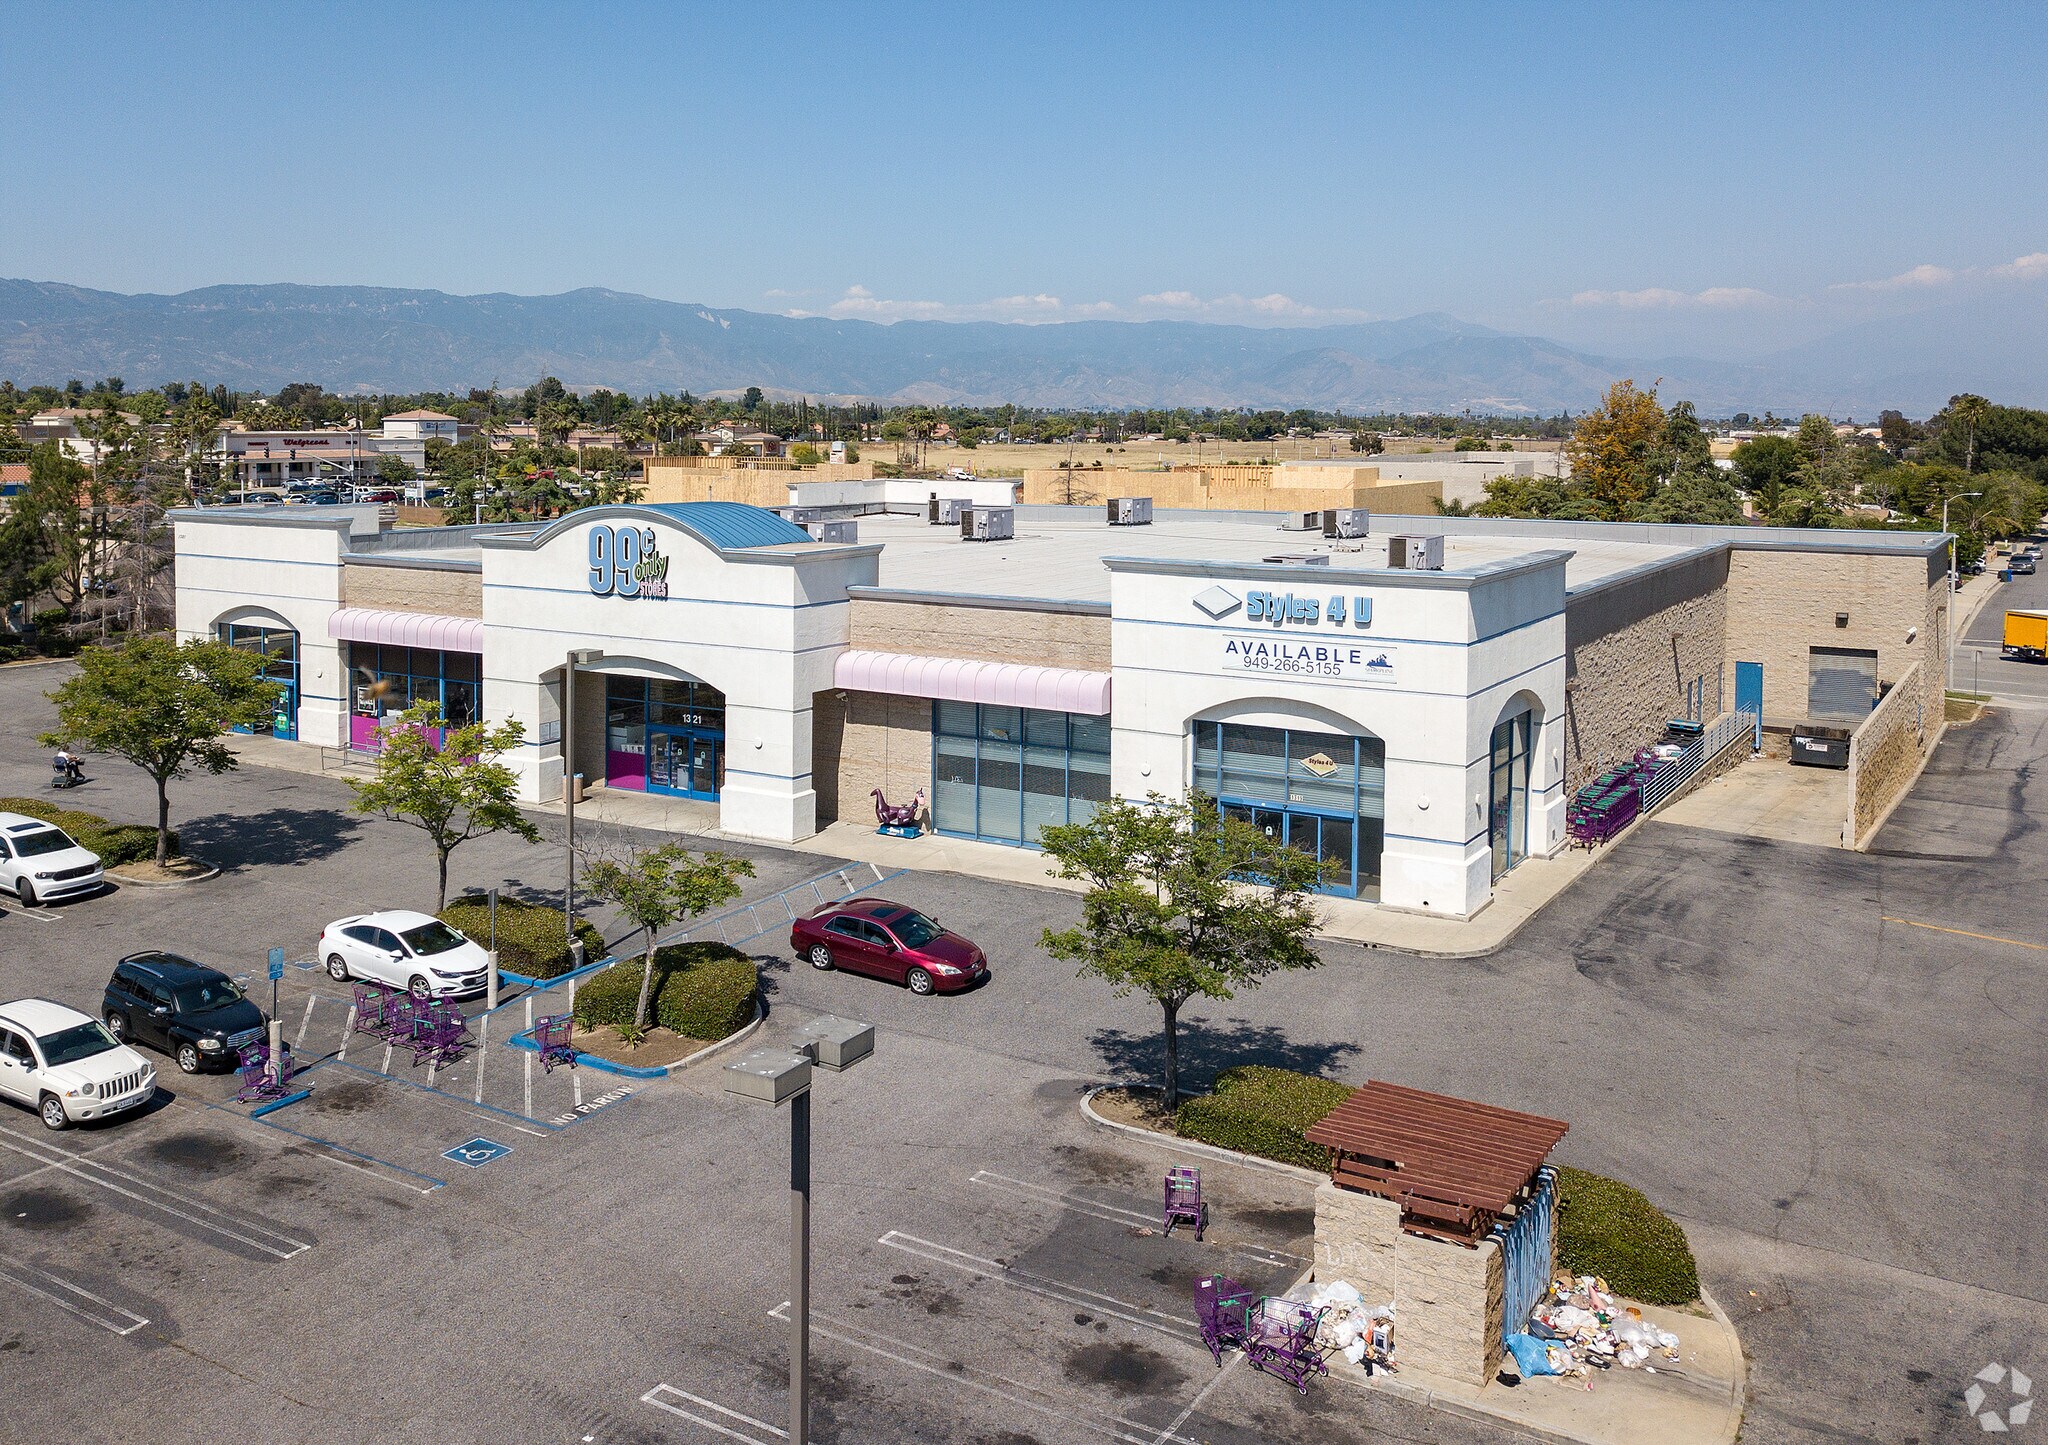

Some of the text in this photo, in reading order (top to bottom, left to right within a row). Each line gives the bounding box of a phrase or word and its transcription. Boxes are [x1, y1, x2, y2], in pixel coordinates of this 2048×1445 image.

[283, 438, 330, 447] Walgreens
[634, 551, 668, 581] only
[639, 580, 667, 598] STORES
[1247, 590, 1373, 624] Styles 4 U
[1226, 640, 1361, 664] AVAILABLE
[1243, 655, 1341, 676] 949-266-5155
[1308, 758, 1324, 766] Styles
[549, 1113, 577, 1126] NO
